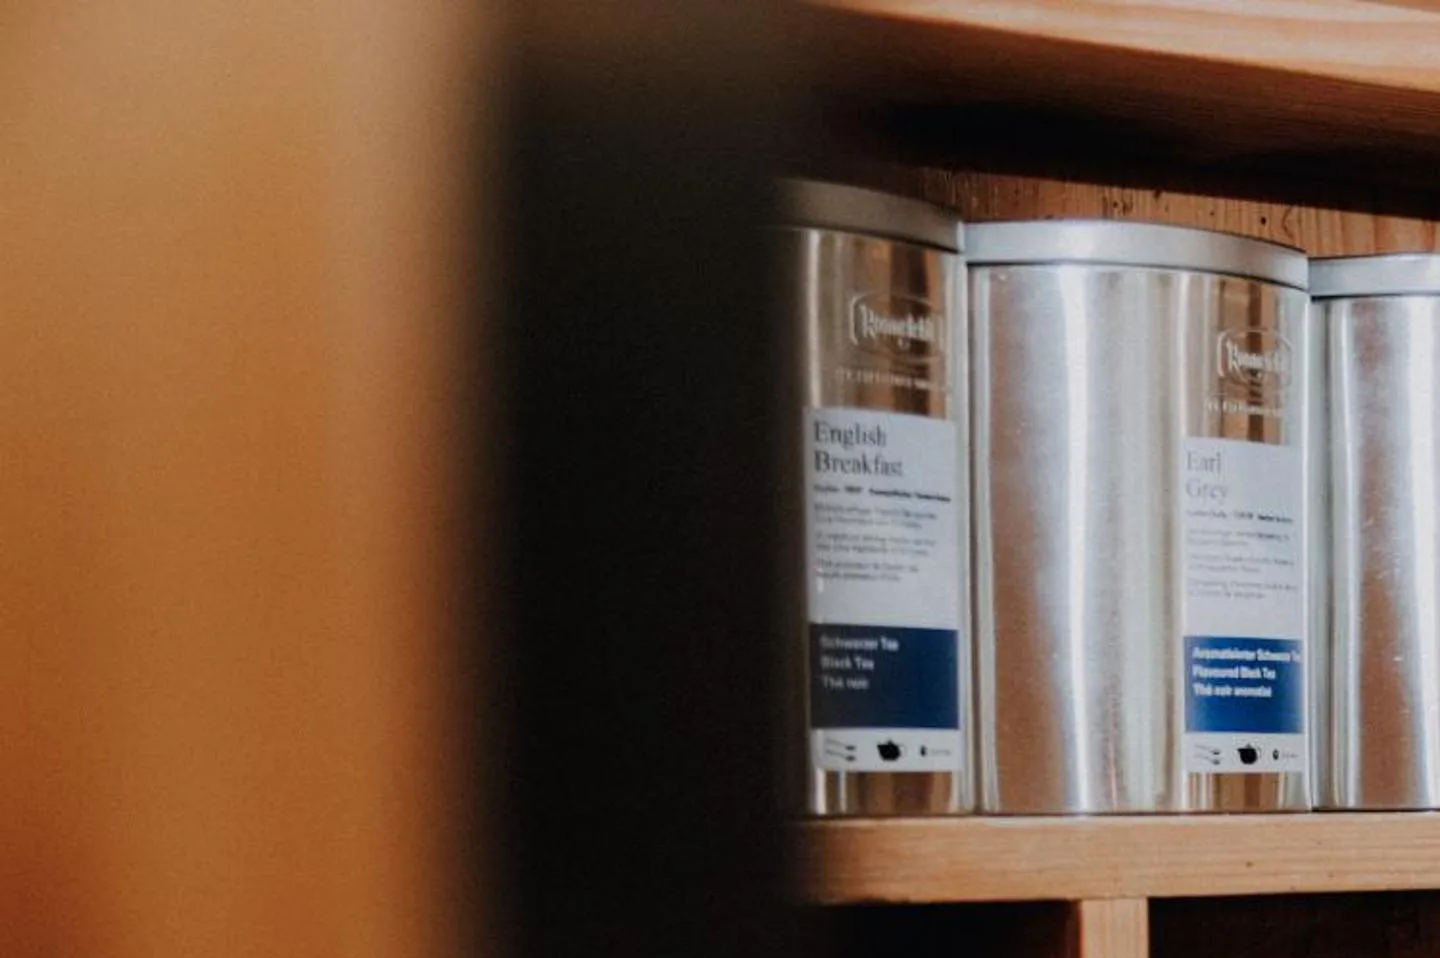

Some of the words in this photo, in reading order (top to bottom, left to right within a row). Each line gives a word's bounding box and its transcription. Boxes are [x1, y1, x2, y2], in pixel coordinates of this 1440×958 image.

[813, 419, 887, 447] English
[813, 450, 904, 477] Breakfast
[1186, 450, 1222, 473] Earl
